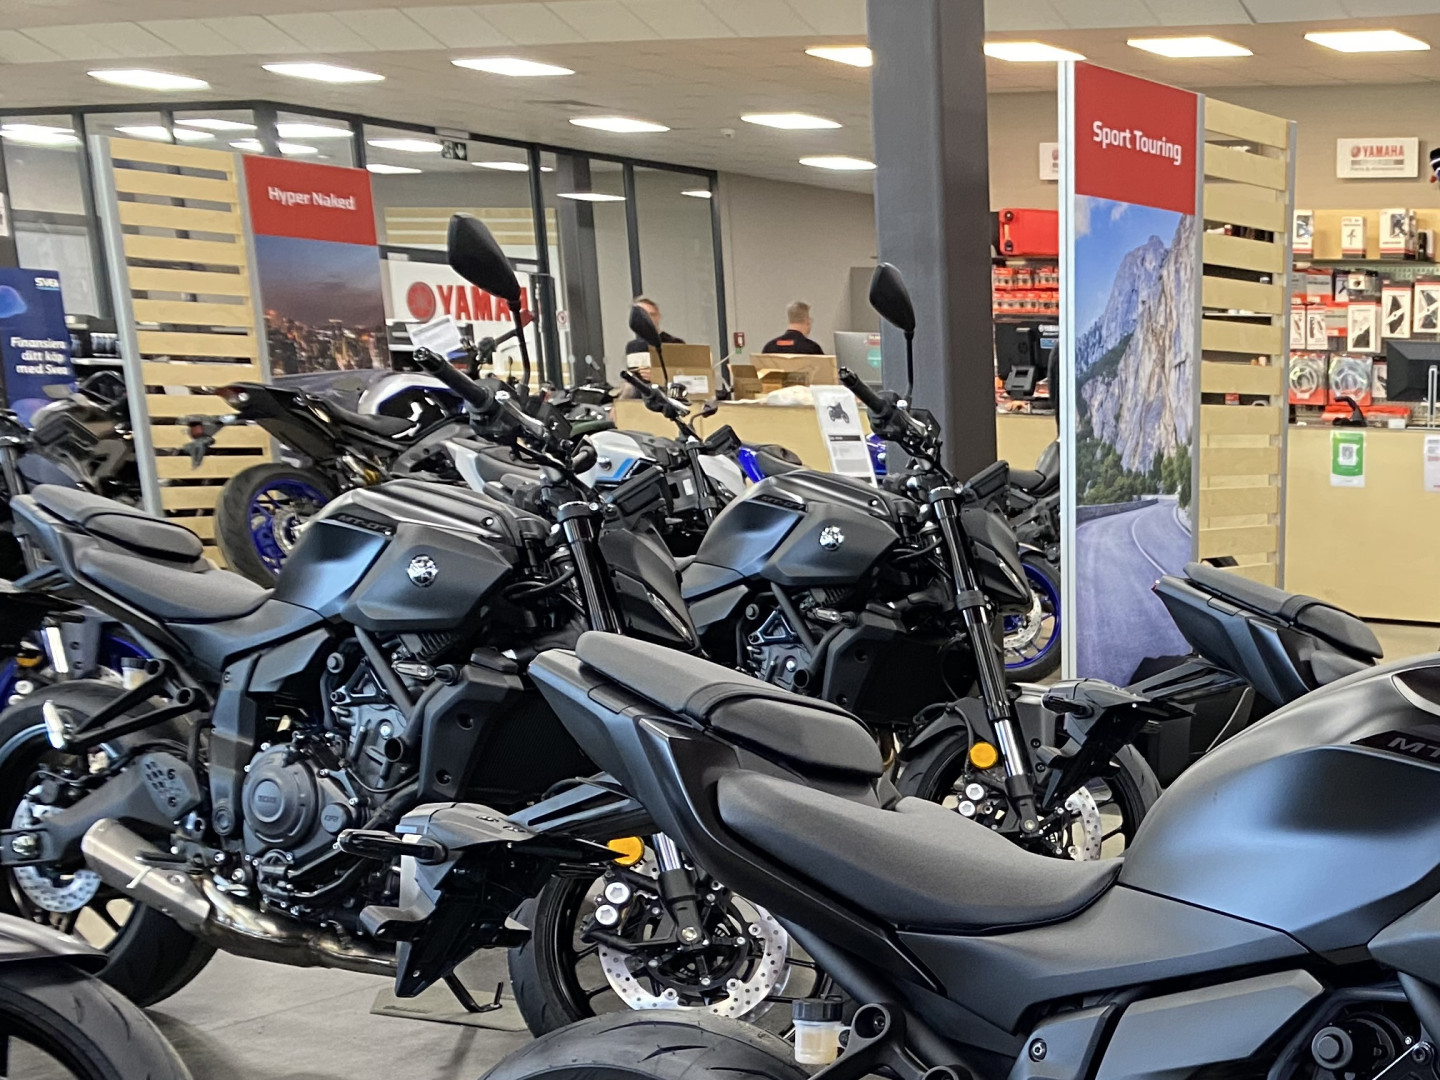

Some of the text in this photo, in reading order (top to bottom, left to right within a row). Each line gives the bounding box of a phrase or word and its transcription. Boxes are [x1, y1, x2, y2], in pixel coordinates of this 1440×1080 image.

[1093, 121, 1182, 166] Sport Touring
[1362, 145, 1404, 157] YAMAHA
[267, 186, 357, 210] Hyper Naked
